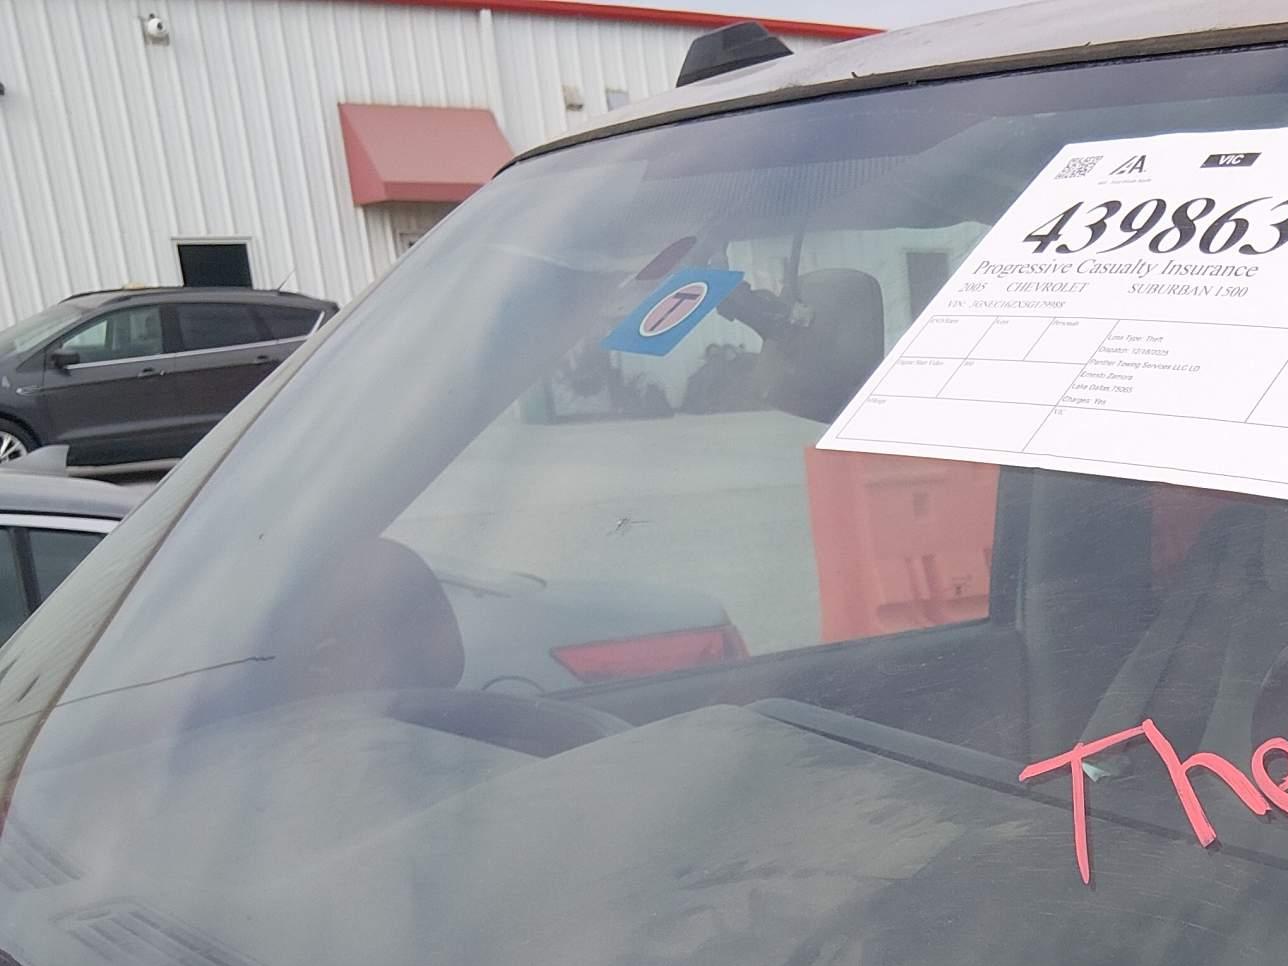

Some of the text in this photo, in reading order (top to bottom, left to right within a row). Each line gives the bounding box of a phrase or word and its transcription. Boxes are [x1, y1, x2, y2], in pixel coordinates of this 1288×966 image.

[1218, 154, 1245, 165] VIC
[972, 259, 1259, 278] Progressive Casualty Insurance
[958, 282, 1249, 298] 2005 CHEVROLET SUBURBAN 1500
[1146, 335, 1164, 343] Theft
[1142, 362, 1171, 371] Services
